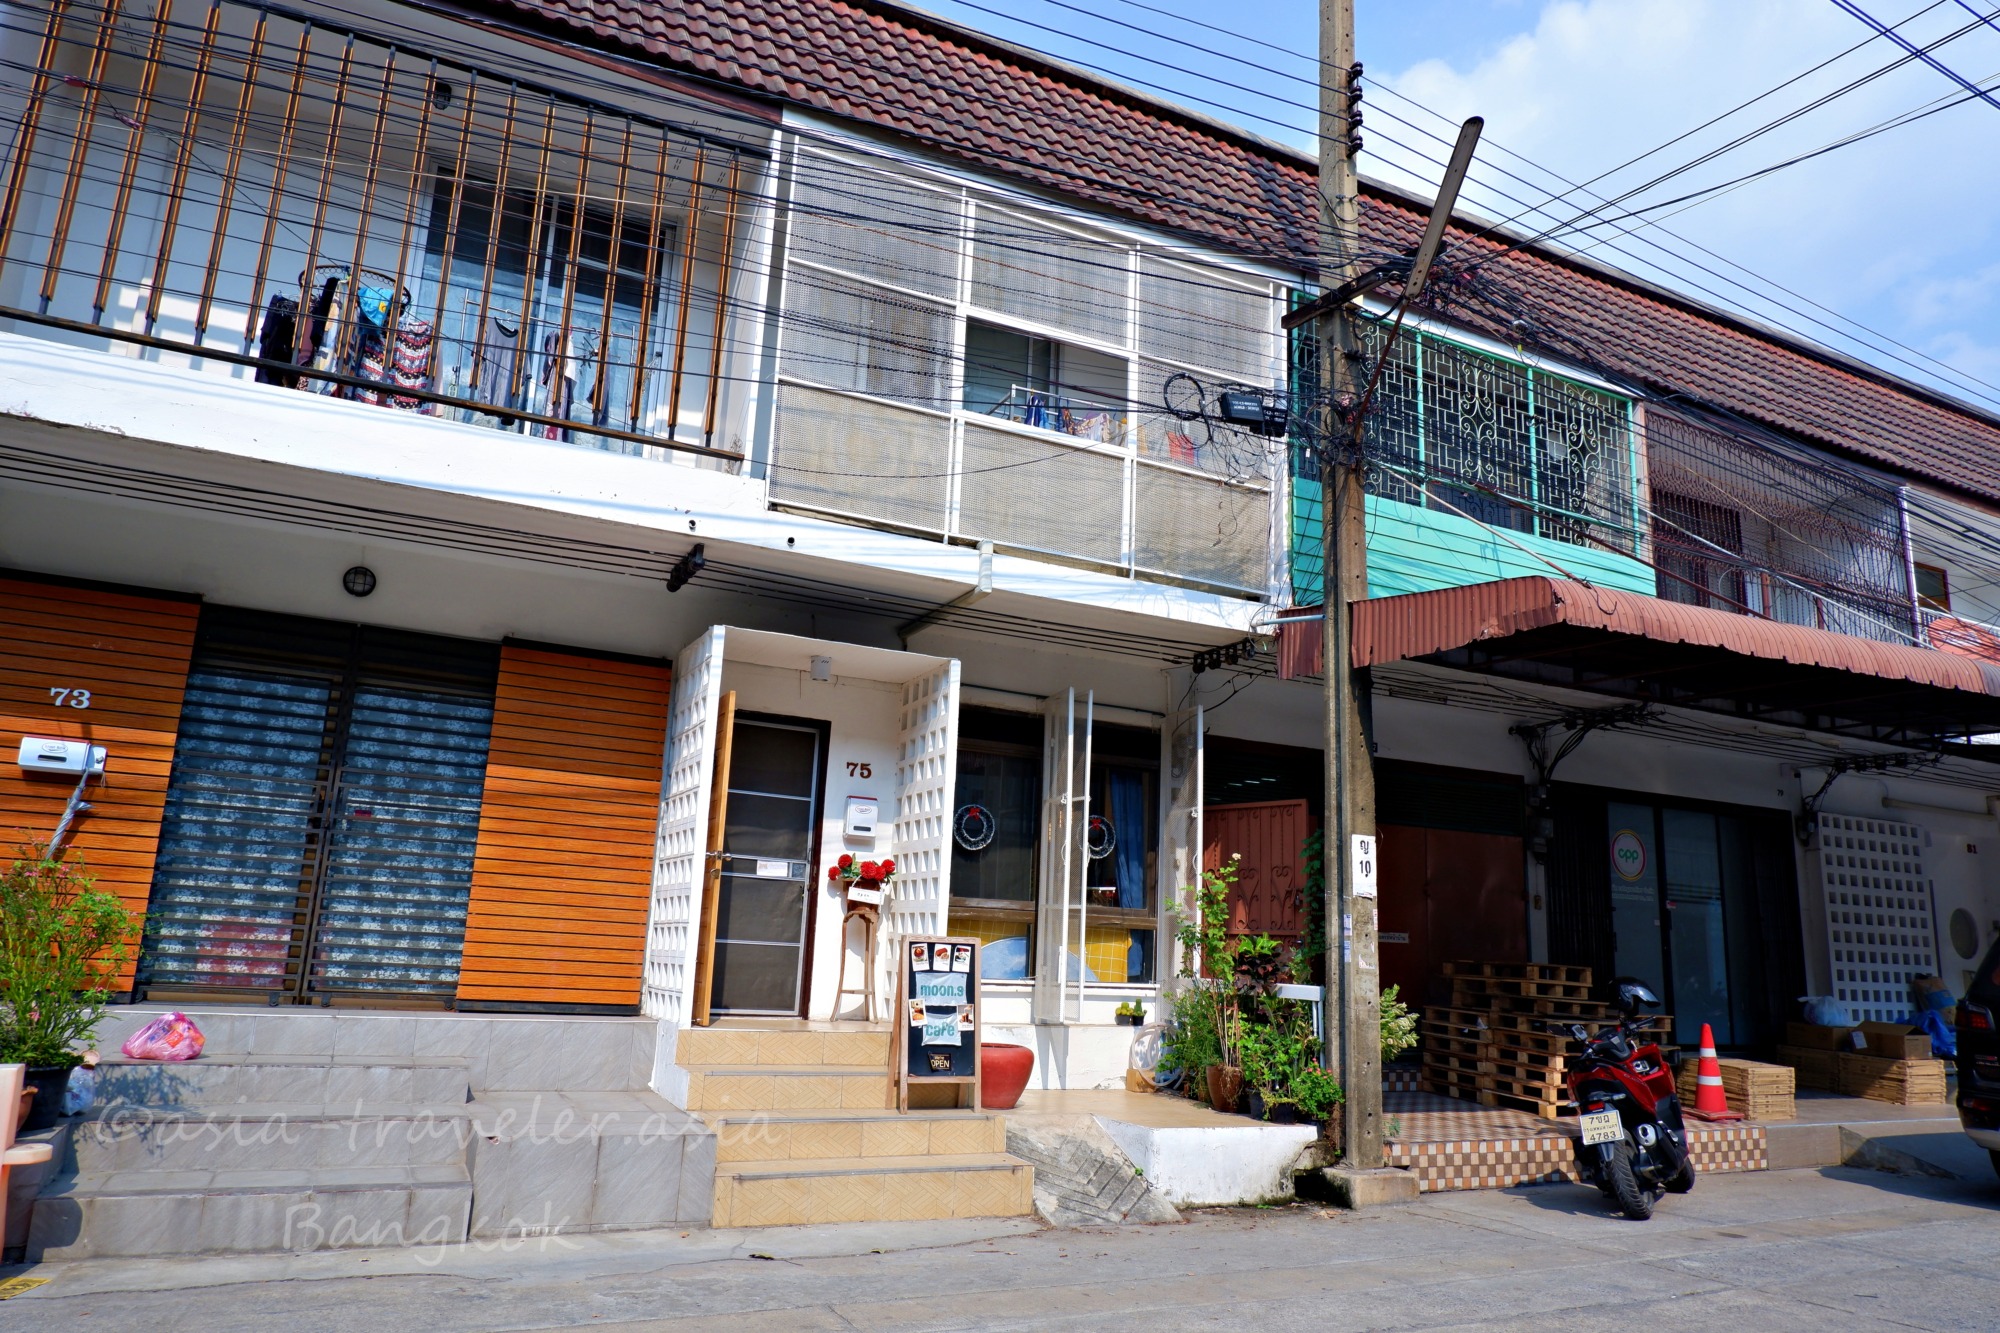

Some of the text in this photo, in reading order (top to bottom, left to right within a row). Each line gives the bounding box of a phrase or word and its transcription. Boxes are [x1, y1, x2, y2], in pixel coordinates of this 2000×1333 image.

[50, 687, 91, 709] 73
[846, 761, 872, 779] 75
[1966, 843, 1978, 854] 81
[1618, 848, 1639, 864] cpp
[930, 1059, 950, 1068] OPEN
[1590, 1130, 1617, 1142] 4783
